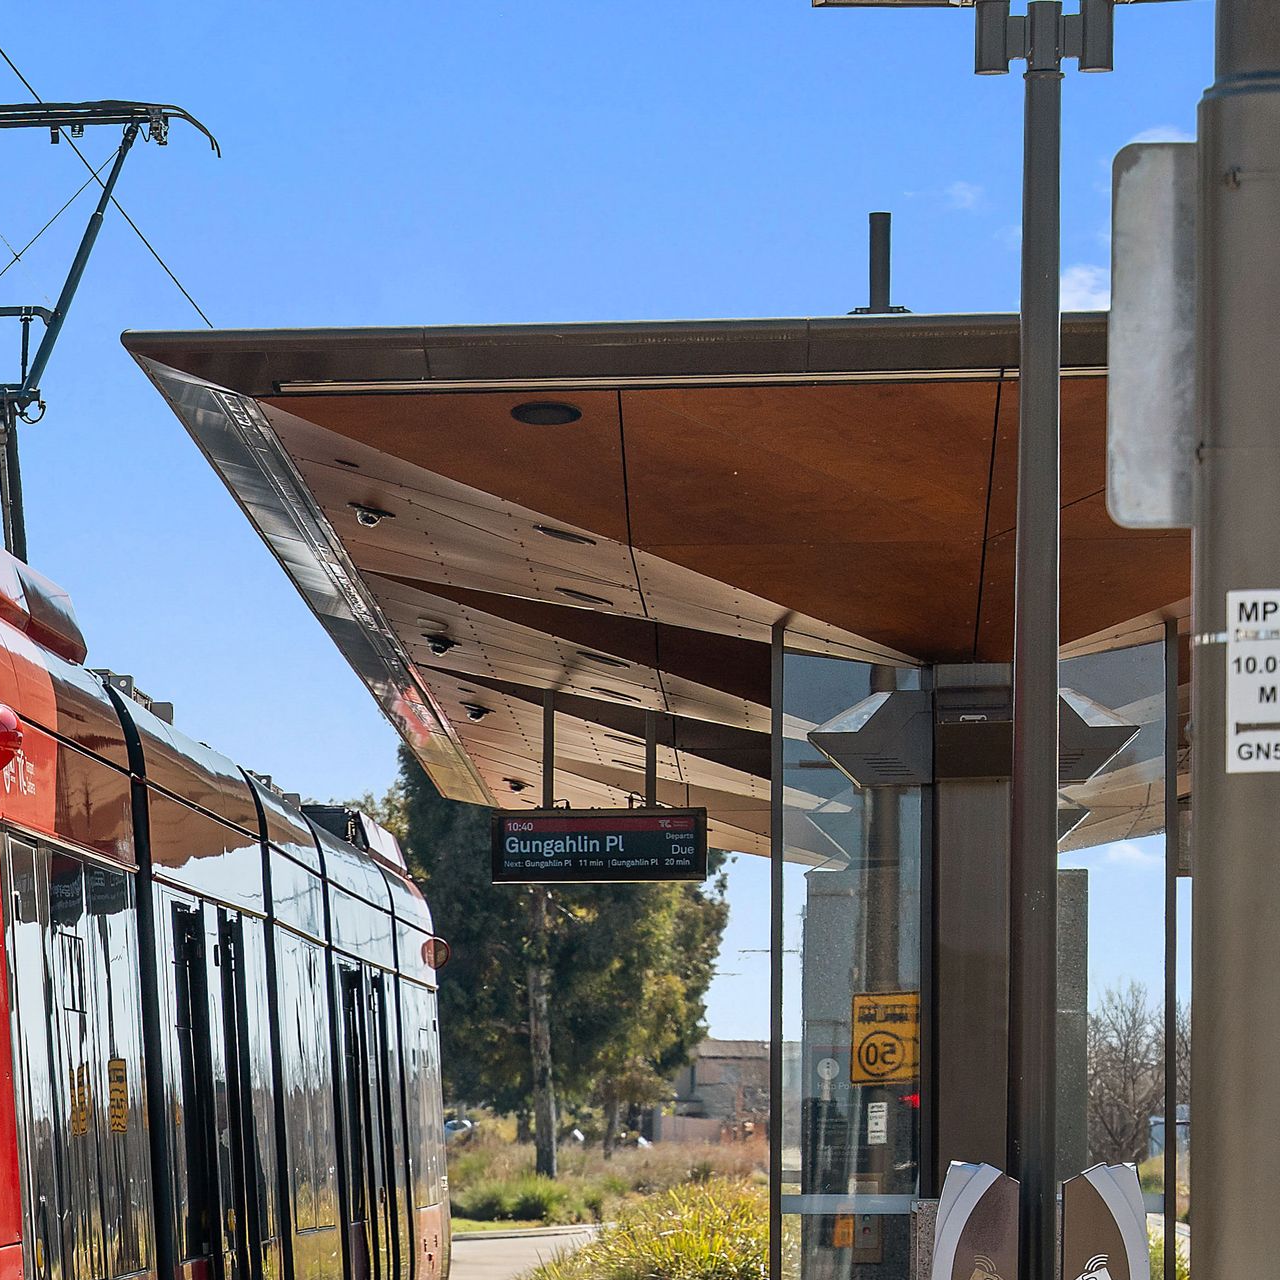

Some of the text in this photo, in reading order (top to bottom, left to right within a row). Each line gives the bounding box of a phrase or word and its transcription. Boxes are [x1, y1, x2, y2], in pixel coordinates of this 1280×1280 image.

[1233, 655, 1280, 674] 10.0
[507, 822, 534, 832] 10:40
[665, 832, 694, 841] Departs
[505, 835, 624, 857] Gungahlin Pl
[671, 844, 695, 854] Due
[524, 860, 563, 869] Gungahlin
[579, 859, 587, 867] 11
[589, 859, 604, 867] min
[650, 858, 659, 866] Pl
[665, 858, 674, 866] 20
[676, 858, 691, 866] min
